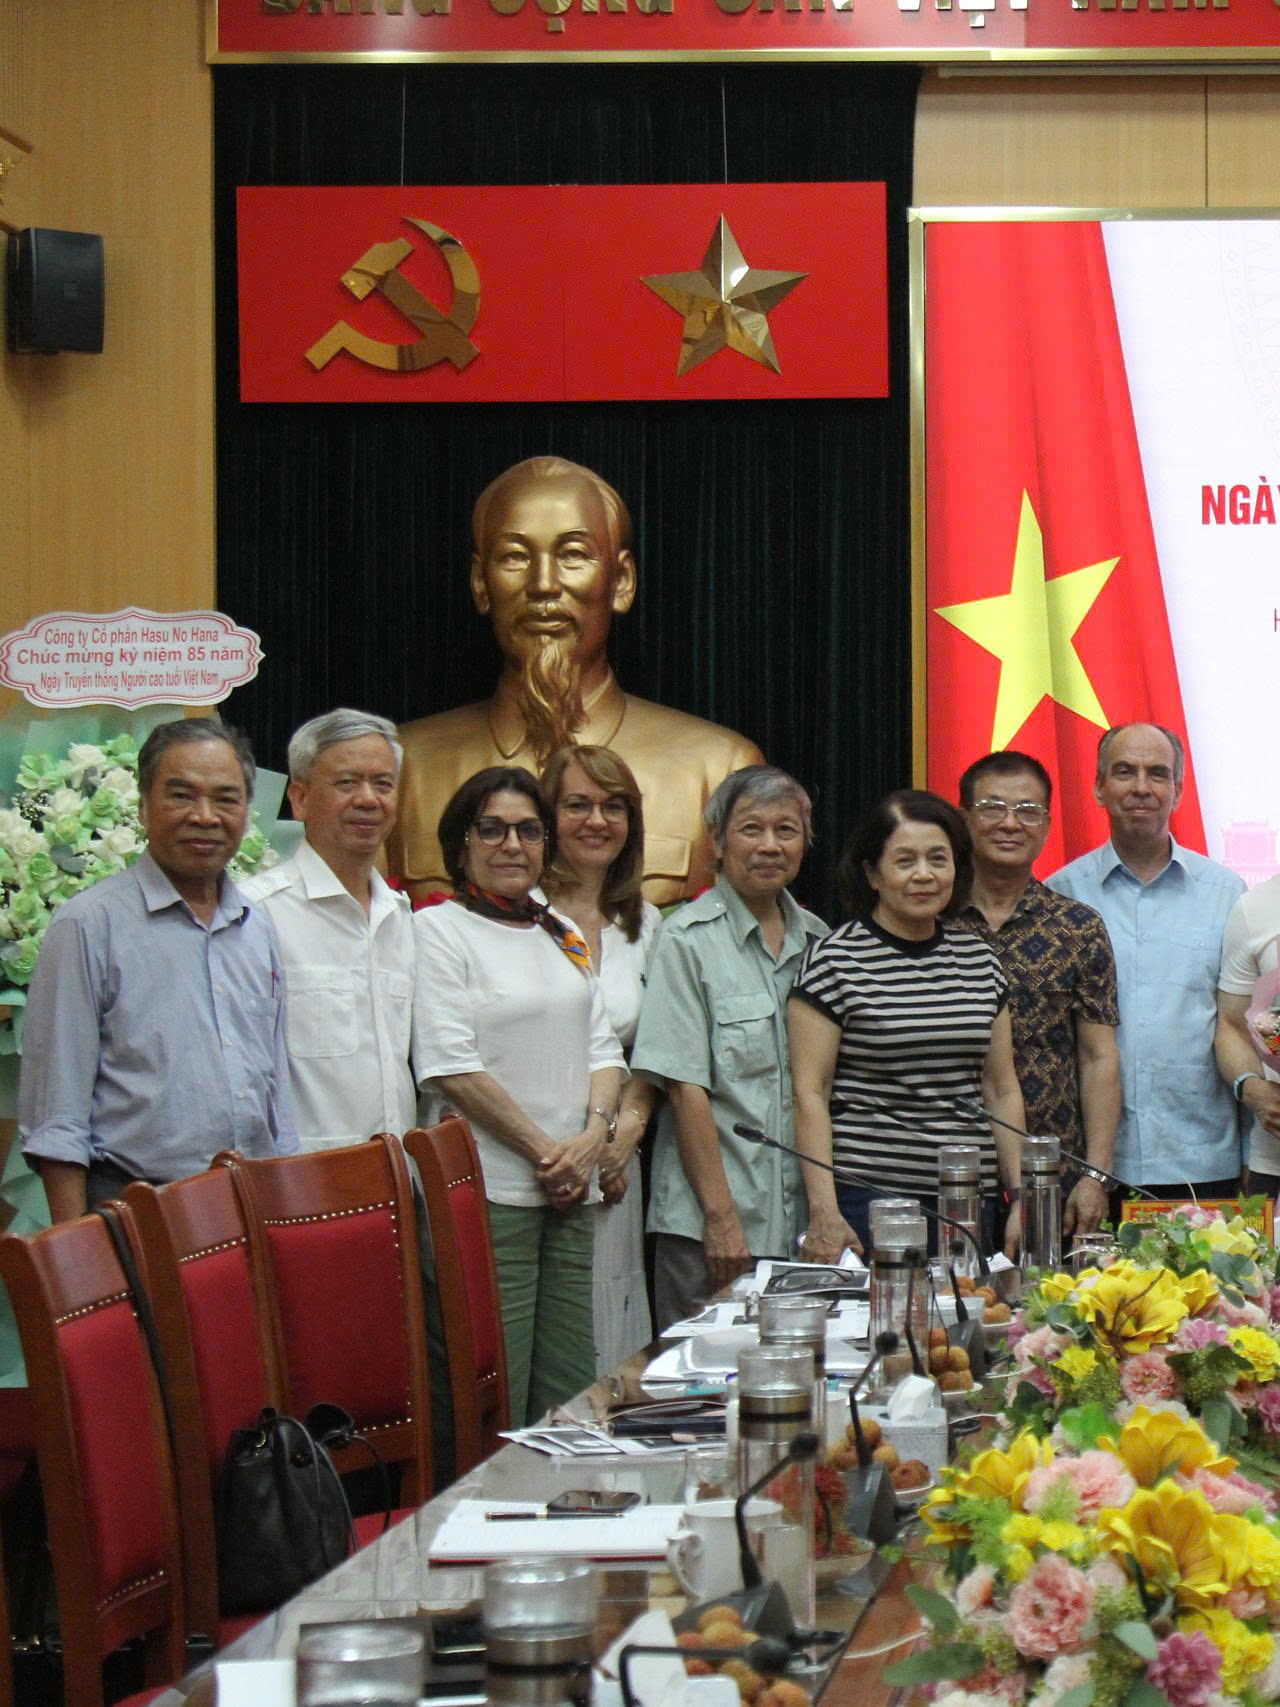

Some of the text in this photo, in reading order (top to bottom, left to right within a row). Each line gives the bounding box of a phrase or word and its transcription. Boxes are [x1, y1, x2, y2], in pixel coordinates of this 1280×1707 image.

[45, 628, 75, 648] Công
[79, 629, 88, 648] ty
[92, 624, 107, 644] Cổ
[141, 627, 169, 643] Hasu
[172, 627, 187, 642] No
[191, 626, 219, 642] Hana
[17, 648, 60, 665] Chúc
[65, 648, 114, 667] mừng
[143, 647, 182, 665] niệm
[187, 646, 206, 661] 85
[211, 646, 243, 661] năm
[40, 666, 219, 693] Ngày Truyền thống Người cao tuổi Việt Nam
